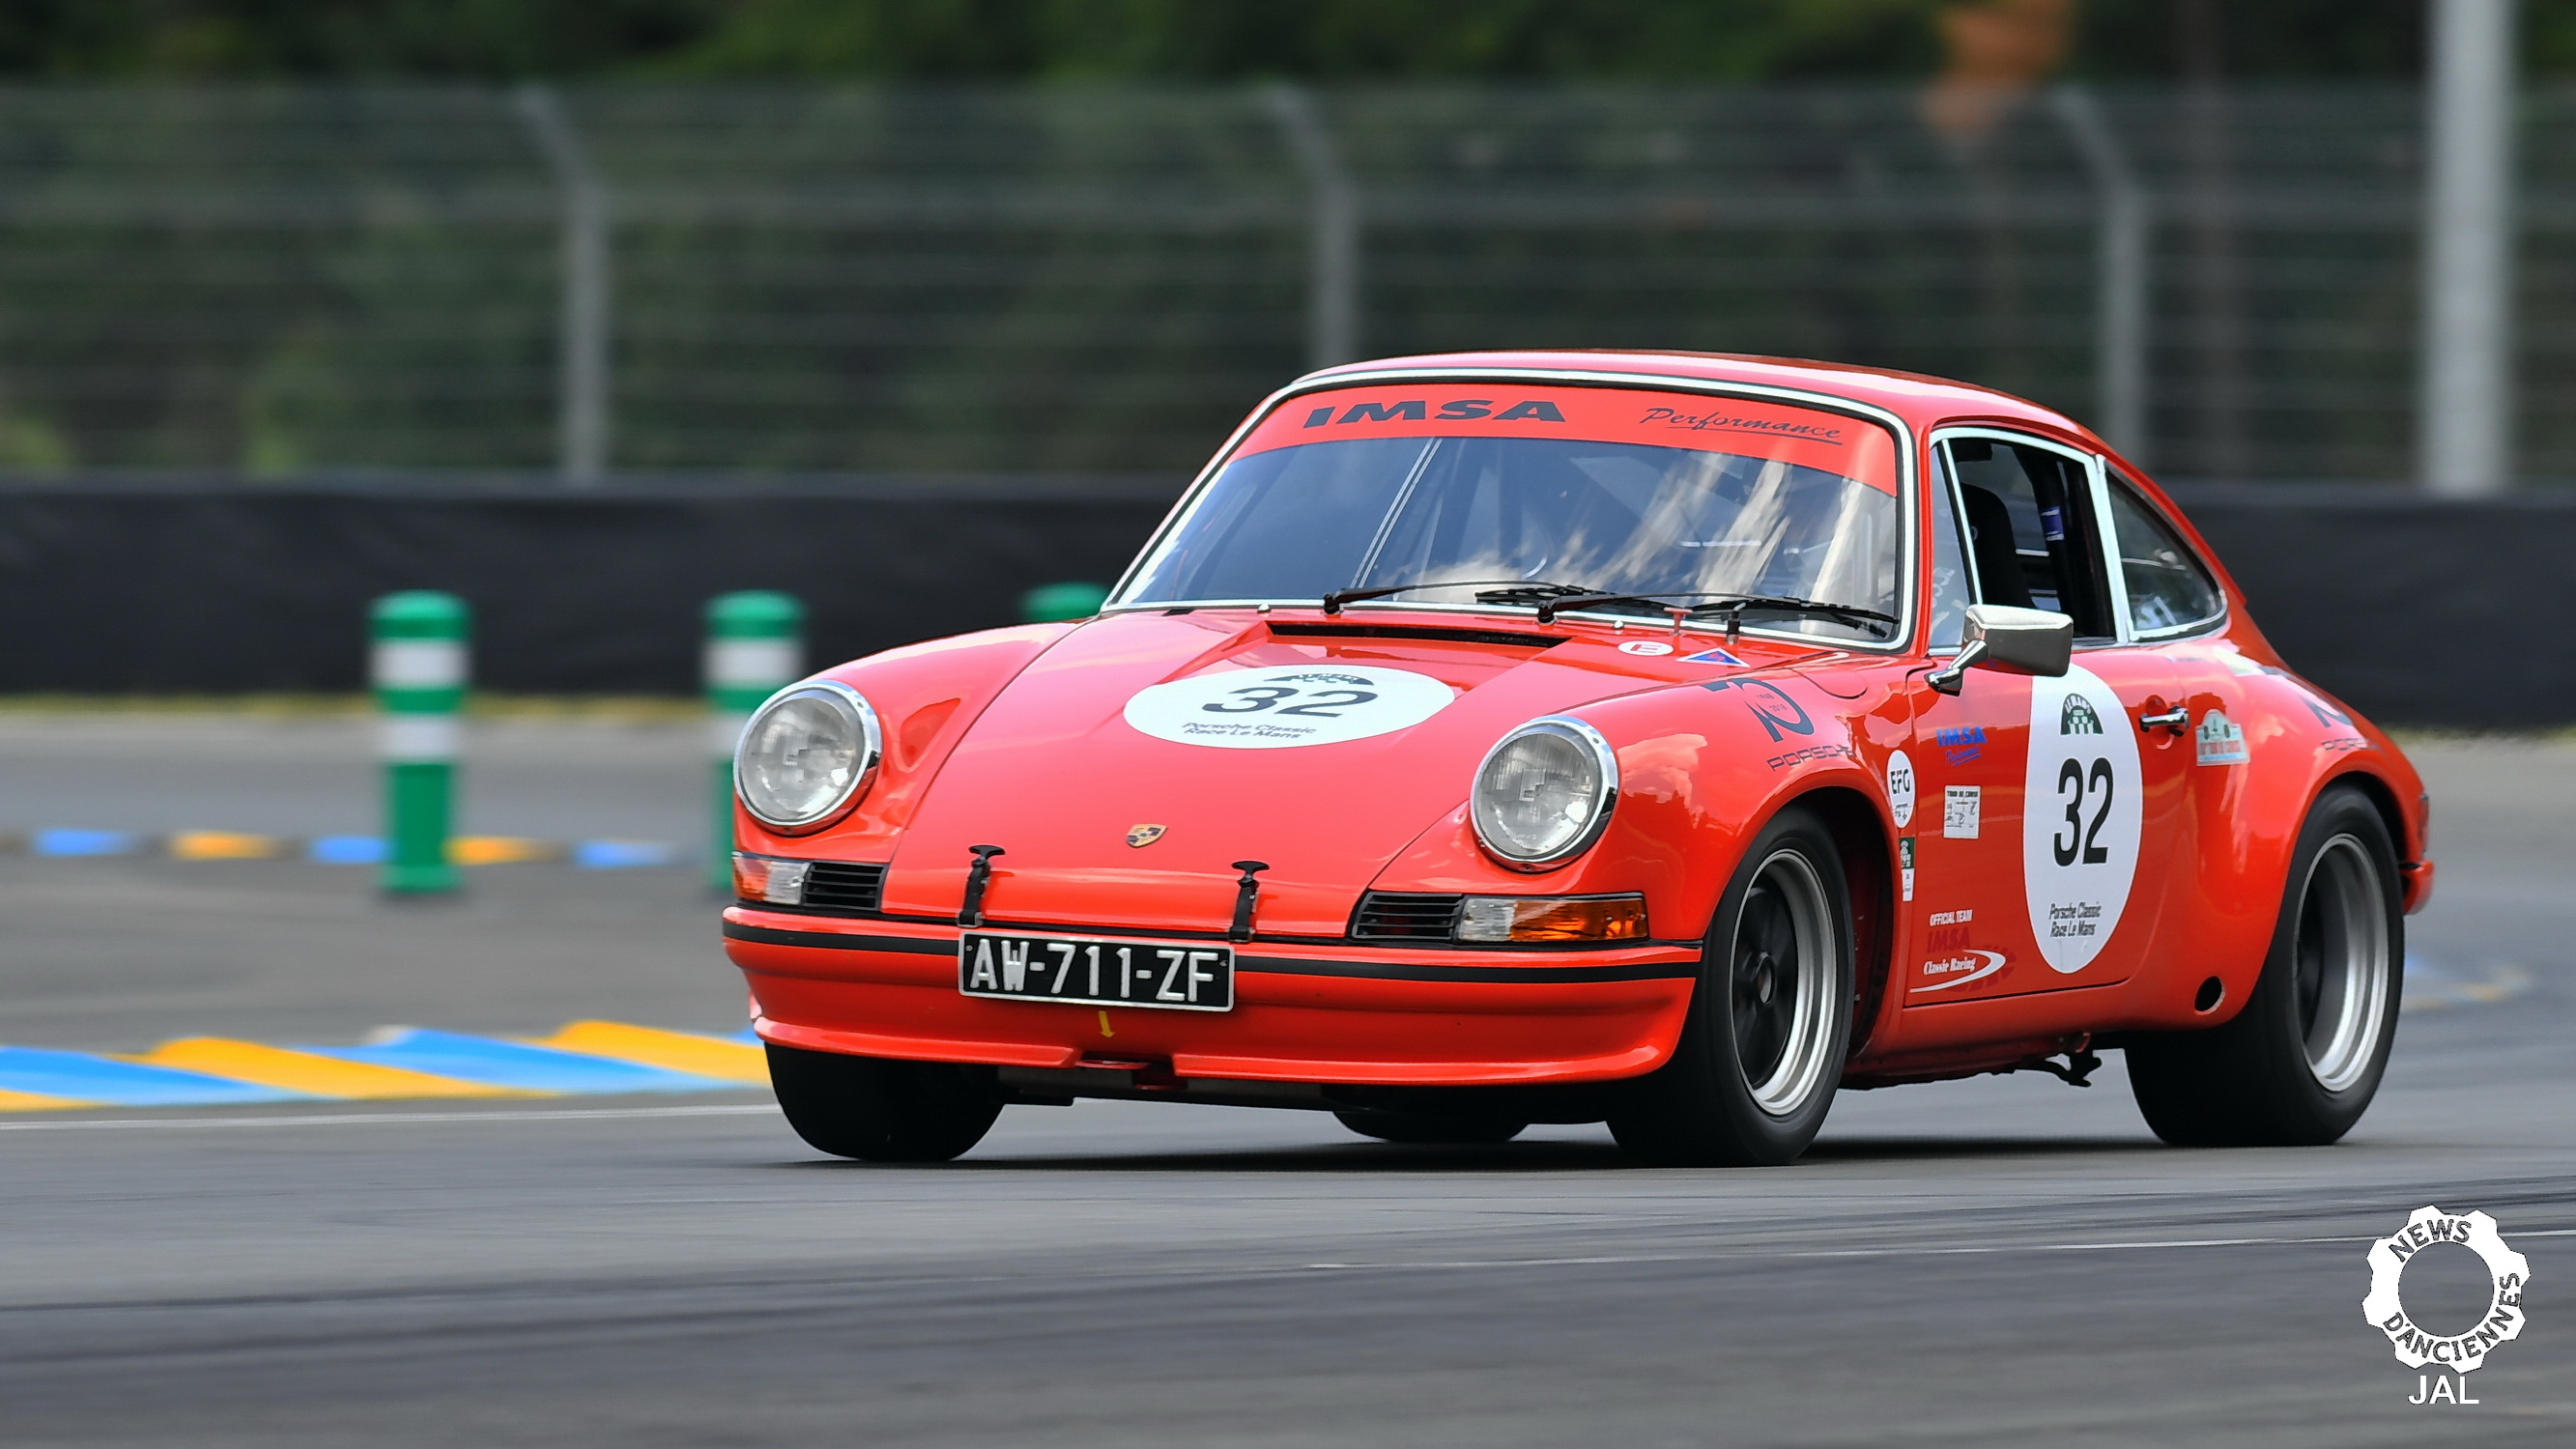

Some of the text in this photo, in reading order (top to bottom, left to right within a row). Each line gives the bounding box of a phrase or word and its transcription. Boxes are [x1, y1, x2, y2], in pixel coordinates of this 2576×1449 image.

[1302, 399, 1841, 439] IMSA Performance
[1201, 686, 1379, 718] 32
[1254, 724, 1317, 734] Classic
[1936, 726, 1988, 747] IMSA
[1890, 769, 1910, 794] EFG
[2054, 757, 2113, 867] 32
[2048, 900, 2102, 920] Porsche Classic
[1928, 927, 1971, 953] IMSA
[2050, 920, 2096, 937] Race Le Mans
[970, 938, 1219, 1003] AW-711-ZF
